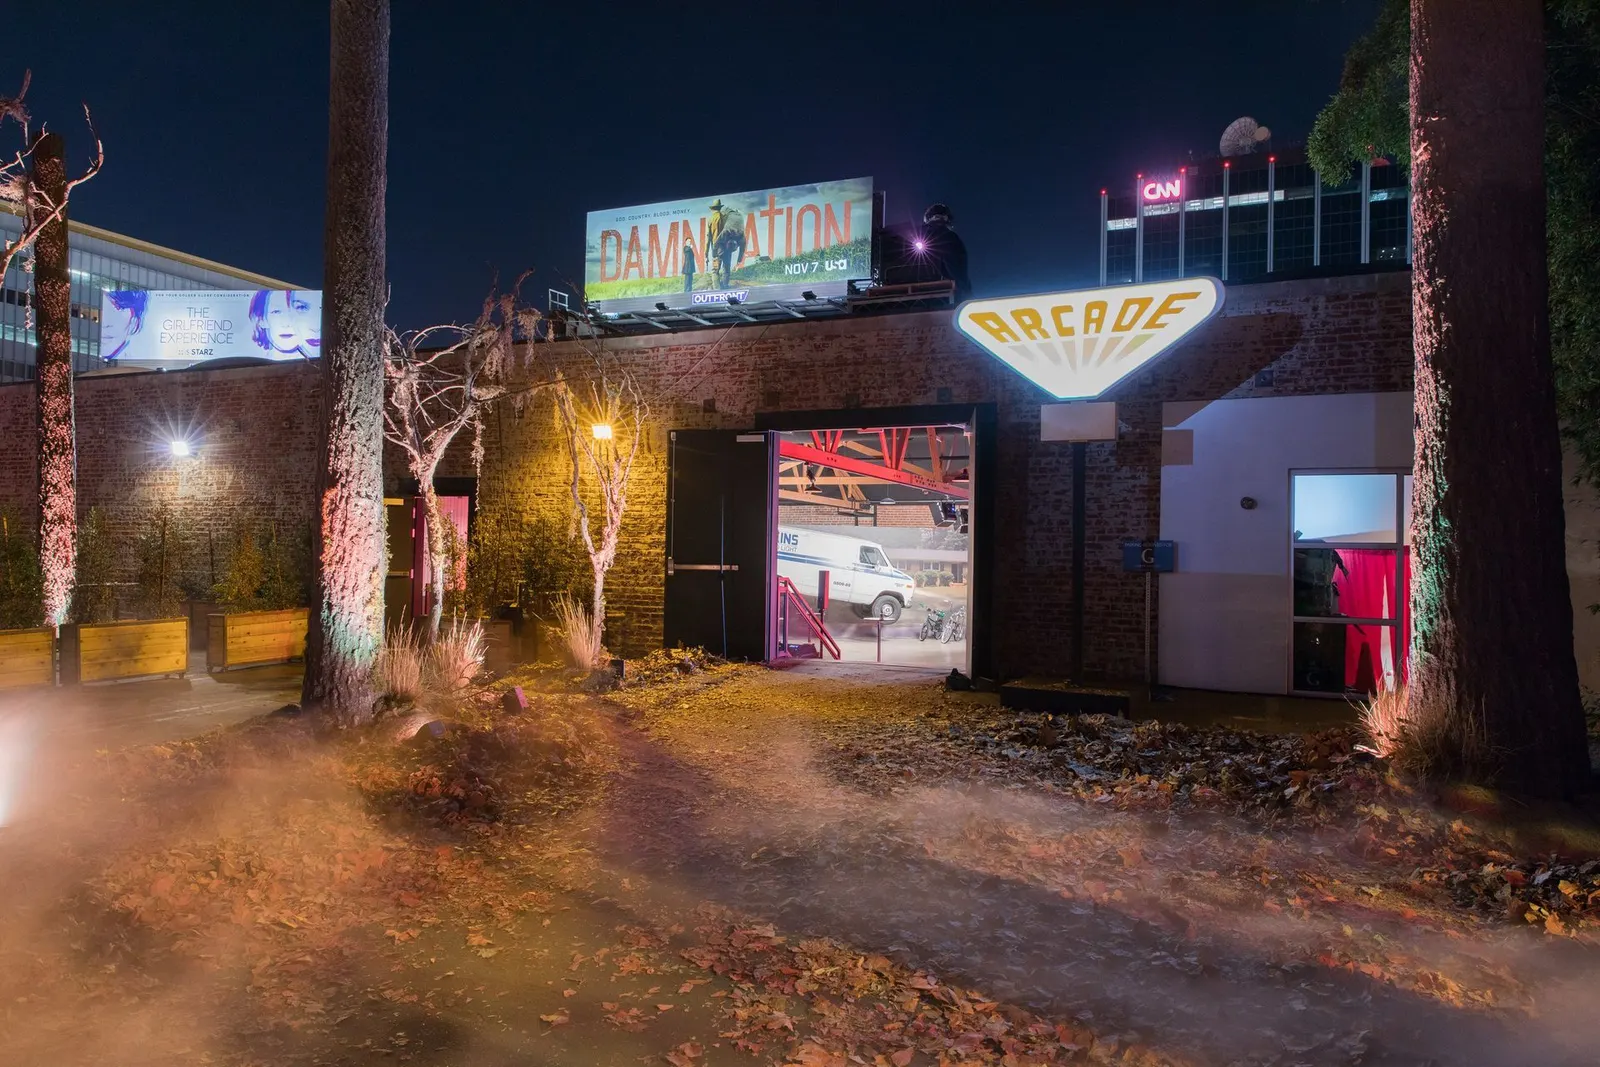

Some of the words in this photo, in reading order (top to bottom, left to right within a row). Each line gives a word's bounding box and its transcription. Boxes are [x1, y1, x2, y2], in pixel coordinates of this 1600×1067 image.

[1143, 179, 1181, 200] CNN
[785, 262, 808, 275] NOV
[811, 261, 819, 273] 7
[186, 306, 210, 318] THE
[968, 292, 1202, 344] ARCADE
[162, 319, 233, 331] GIRLFRIEND
[160, 332, 234, 344] EXPERIENCE
[191, 348, 213, 356] STARZ
[777, 532, 799, 546] INS
[1141, 548, 1154, 563] G
